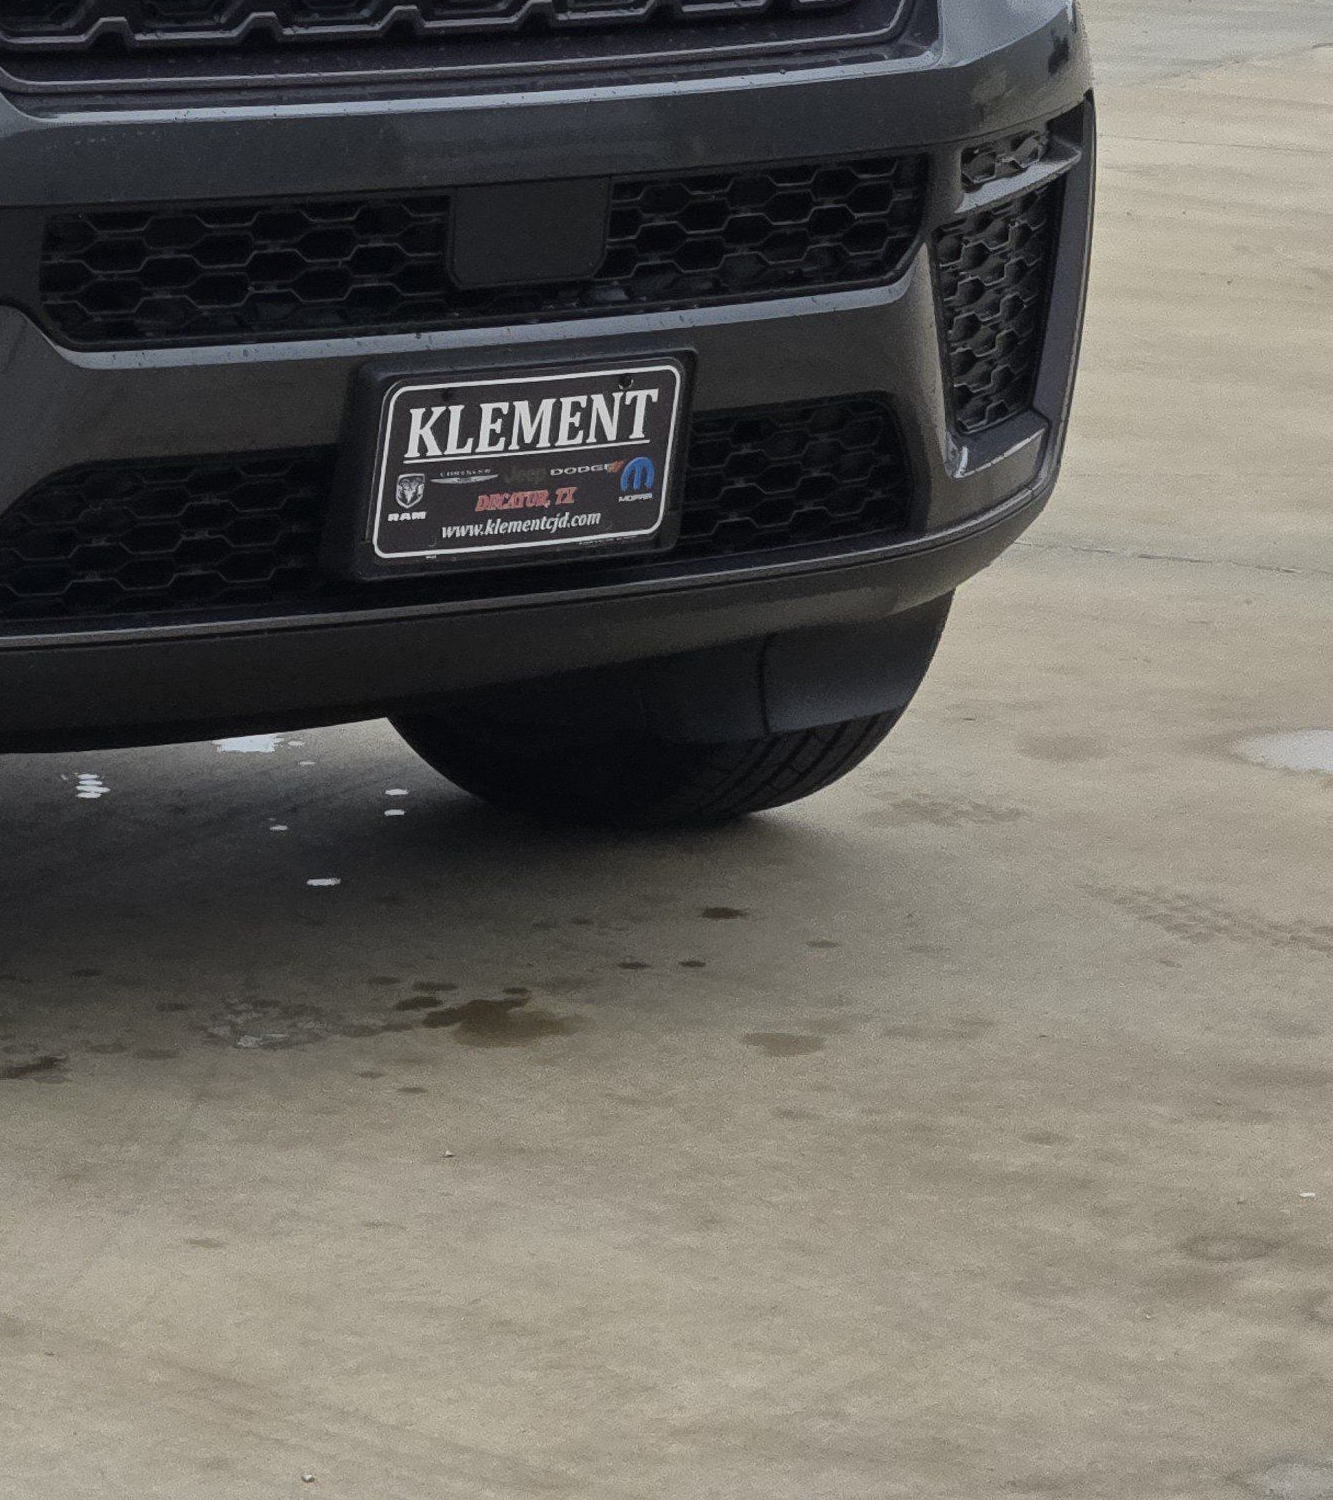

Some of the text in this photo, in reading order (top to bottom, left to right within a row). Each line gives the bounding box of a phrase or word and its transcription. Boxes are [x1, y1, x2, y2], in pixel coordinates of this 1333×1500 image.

[404, 388, 660, 458] KLEMENT
[555, 487, 578, 505] TX
[387, 510, 427, 522] RAM
[442, 511, 602, 538] www.klementcjd.com
